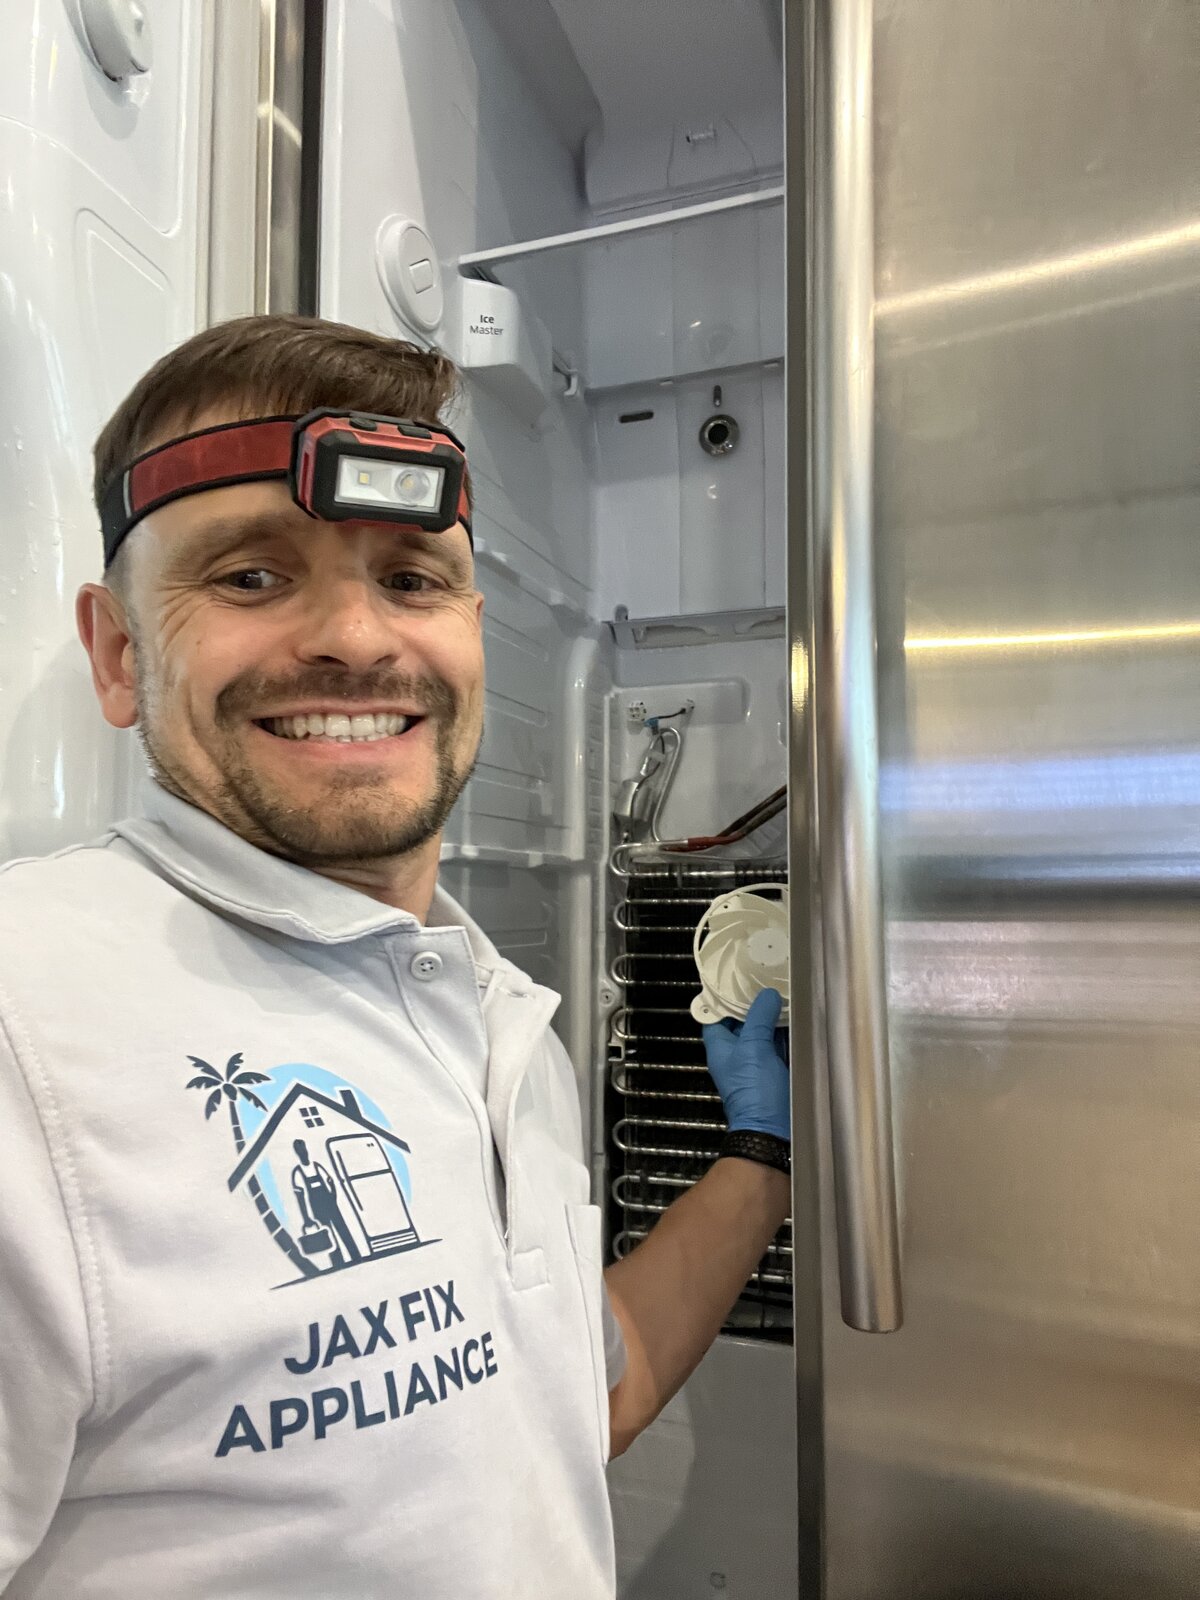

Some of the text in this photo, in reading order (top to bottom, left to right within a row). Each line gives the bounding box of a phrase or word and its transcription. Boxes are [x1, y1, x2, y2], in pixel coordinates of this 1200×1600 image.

[469, 325, 504, 335] Master
[480, 314, 495, 323] Ice
[284, 1280, 465, 1375] JAX FIX
[215, 1332, 498, 1458] APPLIANCE
